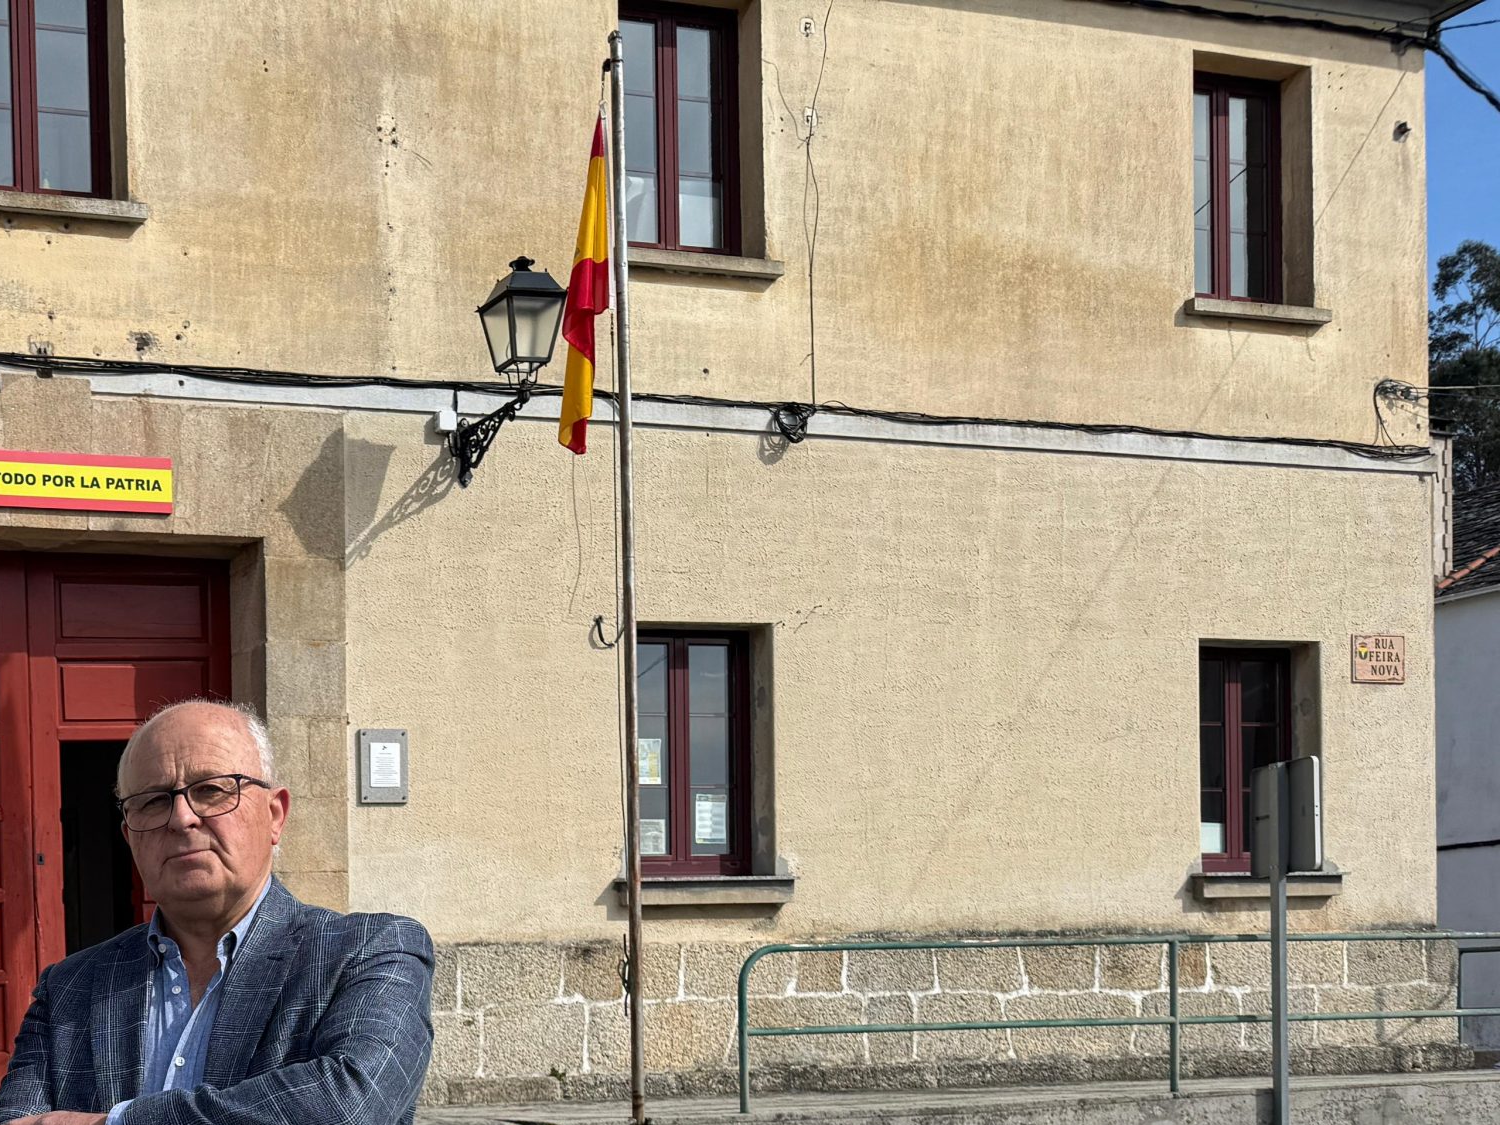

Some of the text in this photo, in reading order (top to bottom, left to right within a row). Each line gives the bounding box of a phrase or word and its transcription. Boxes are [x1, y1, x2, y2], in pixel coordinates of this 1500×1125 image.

[42, 474, 75, 488] POR
[80, 476, 100, 489] LA
[105, 477, 163, 491] PATRIA
[1374, 638, 1395, 649] RUA
[1369, 651, 1401, 662] FEIRA
[1371, 665, 1399, 676] NOVA
